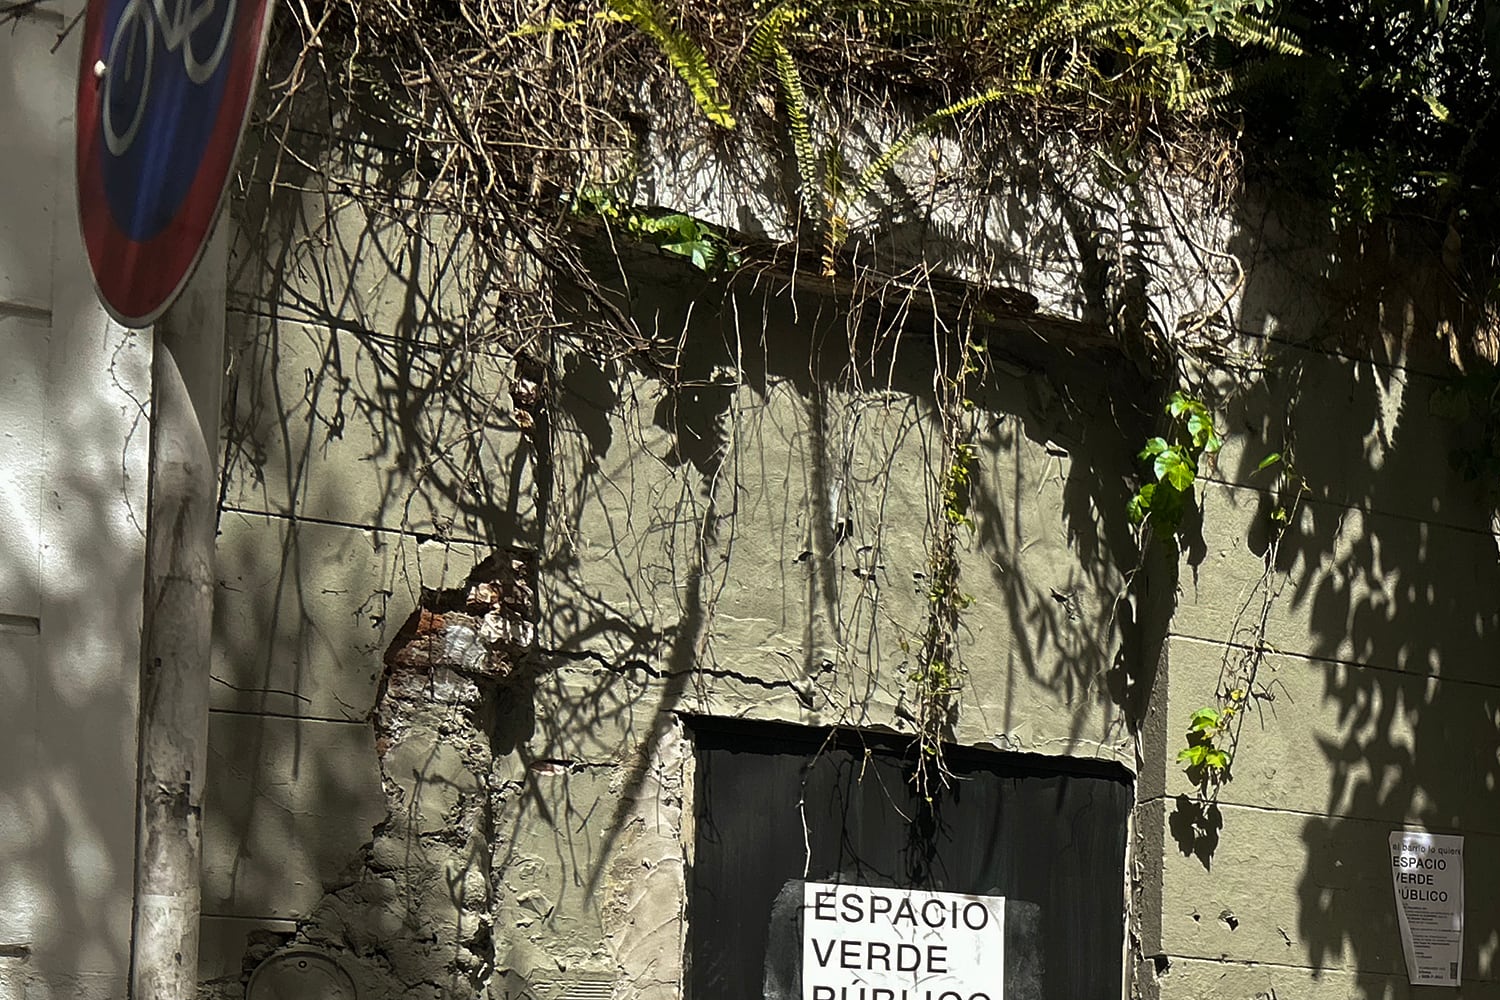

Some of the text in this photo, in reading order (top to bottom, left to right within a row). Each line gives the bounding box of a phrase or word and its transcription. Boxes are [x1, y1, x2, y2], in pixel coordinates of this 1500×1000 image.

[1393, 856, 1447, 870] ESPACIO
[1398, 886, 1448, 902] ÚBLICO
[815, 891, 988, 930] ESPACIO
[811, 938, 947, 973] VERDE
